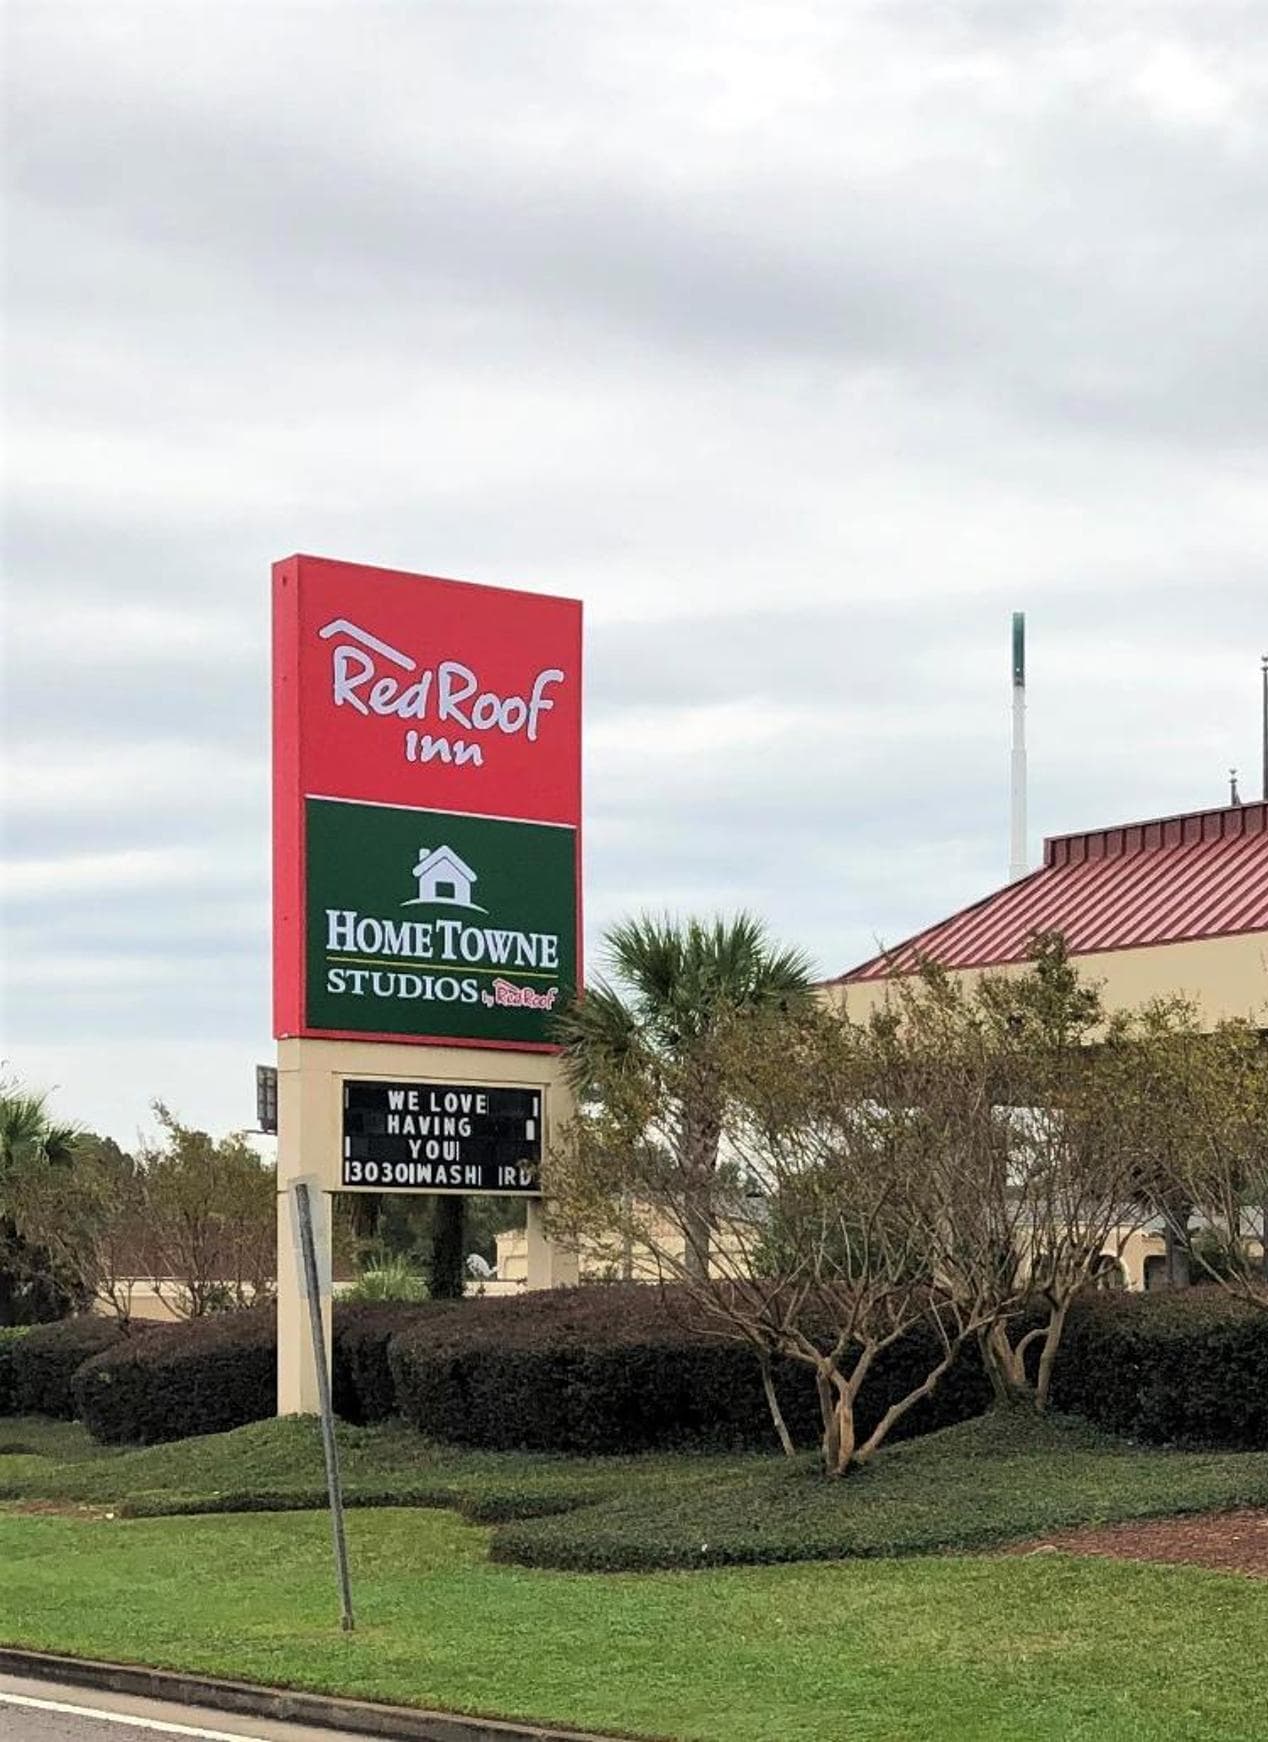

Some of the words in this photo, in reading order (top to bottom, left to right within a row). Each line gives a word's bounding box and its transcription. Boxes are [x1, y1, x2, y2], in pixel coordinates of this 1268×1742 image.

[326, 967, 479, 1004] STUDIOS
[481, 989, 495, 1009] by
[387, 1089, 420, 1111] WE
[429, 1091, 487, 1115] LOVE
[386, 1113, 472, 1138] HAVING
[408, 1138, 456, 1162] YOU
[351, 1160, 410, 1184] 3030
[416, 1162, 477, 1186] WASH
[503, 1165, 532, 1187] RD
